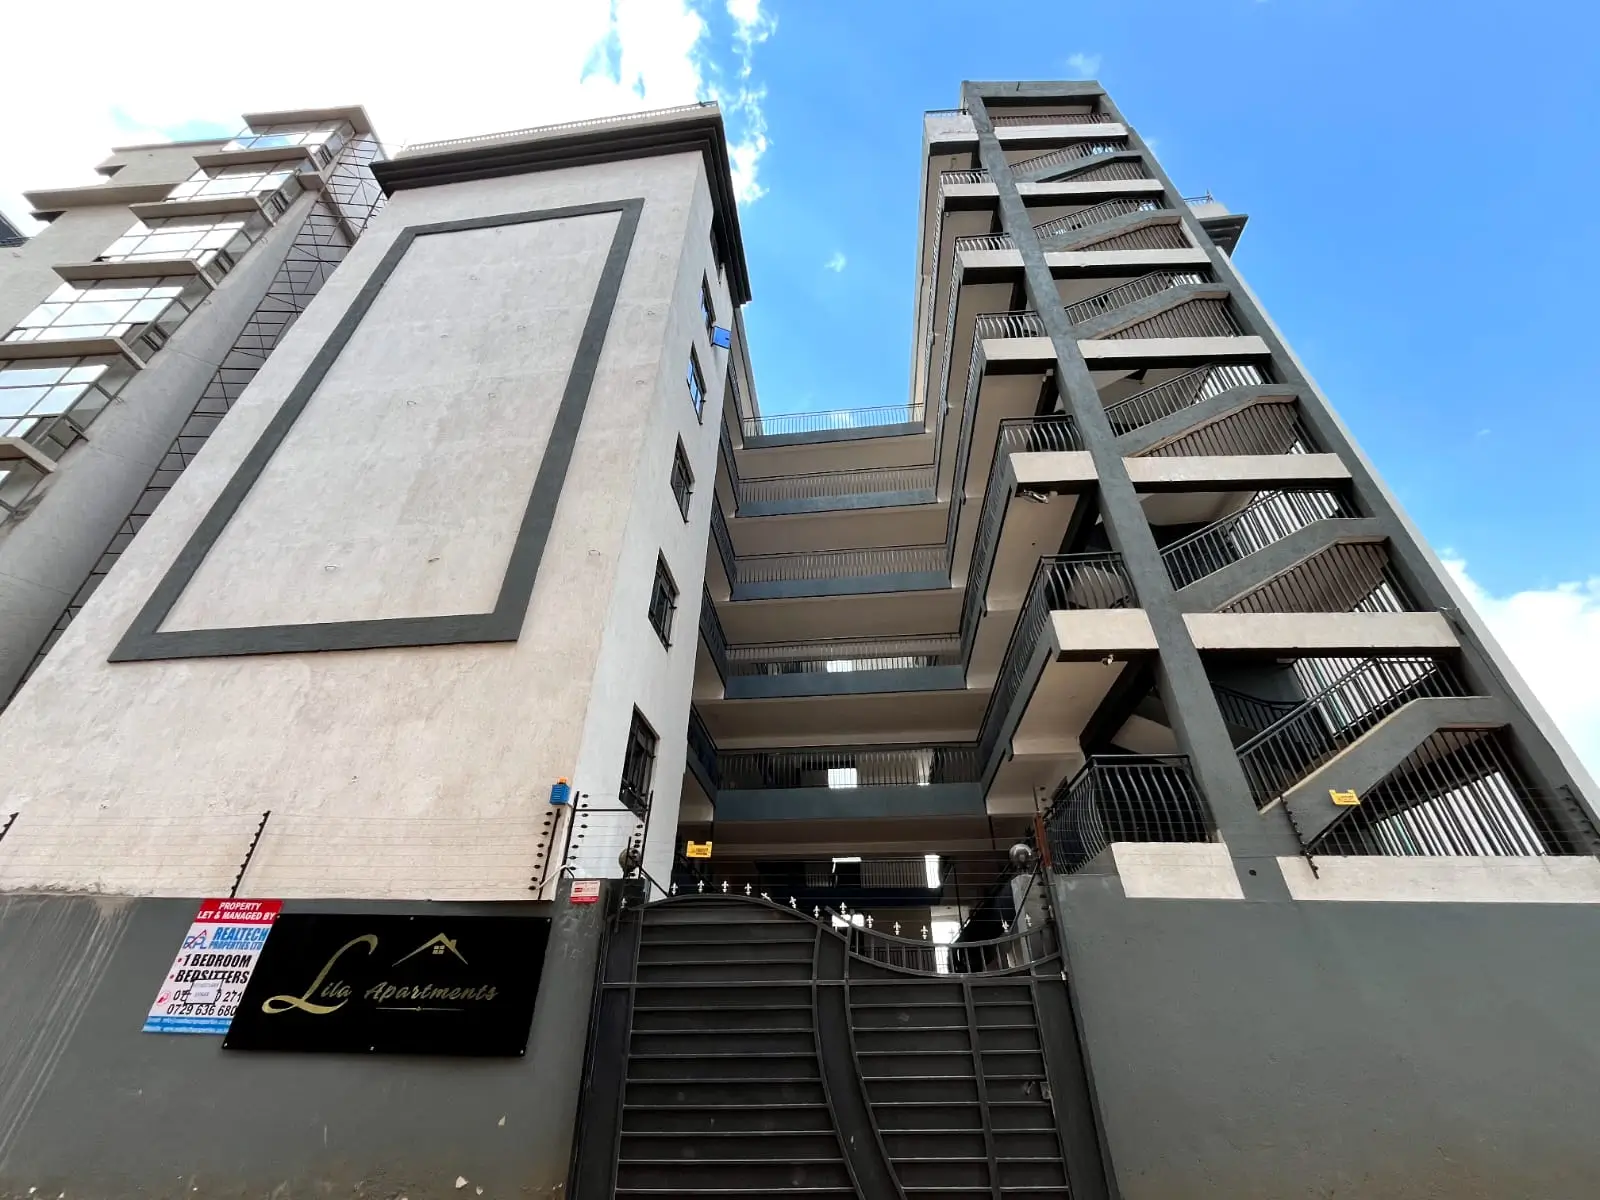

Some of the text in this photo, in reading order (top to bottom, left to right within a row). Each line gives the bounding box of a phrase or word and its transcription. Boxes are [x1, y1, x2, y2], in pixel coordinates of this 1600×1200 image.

[219, 902, 262, 911] PROPERTY
[197, 911, 214, 920] LET
[221, 911, 262, 921] MANAGED
[263, 912, 277, 921] BY
[213, 926, 270, 942] REALTECH
[208, 941, 249, 950] PROPERTIES
[182, 953, 253, 968] 1 BEDROOM
[174, 969, 251, 984] BEDSITTERS
[261, 933, 499, 1014] Lila Apartments
[166, 1003, 194, 1015] 0729
[195, 1004, 216, 1016] 636
